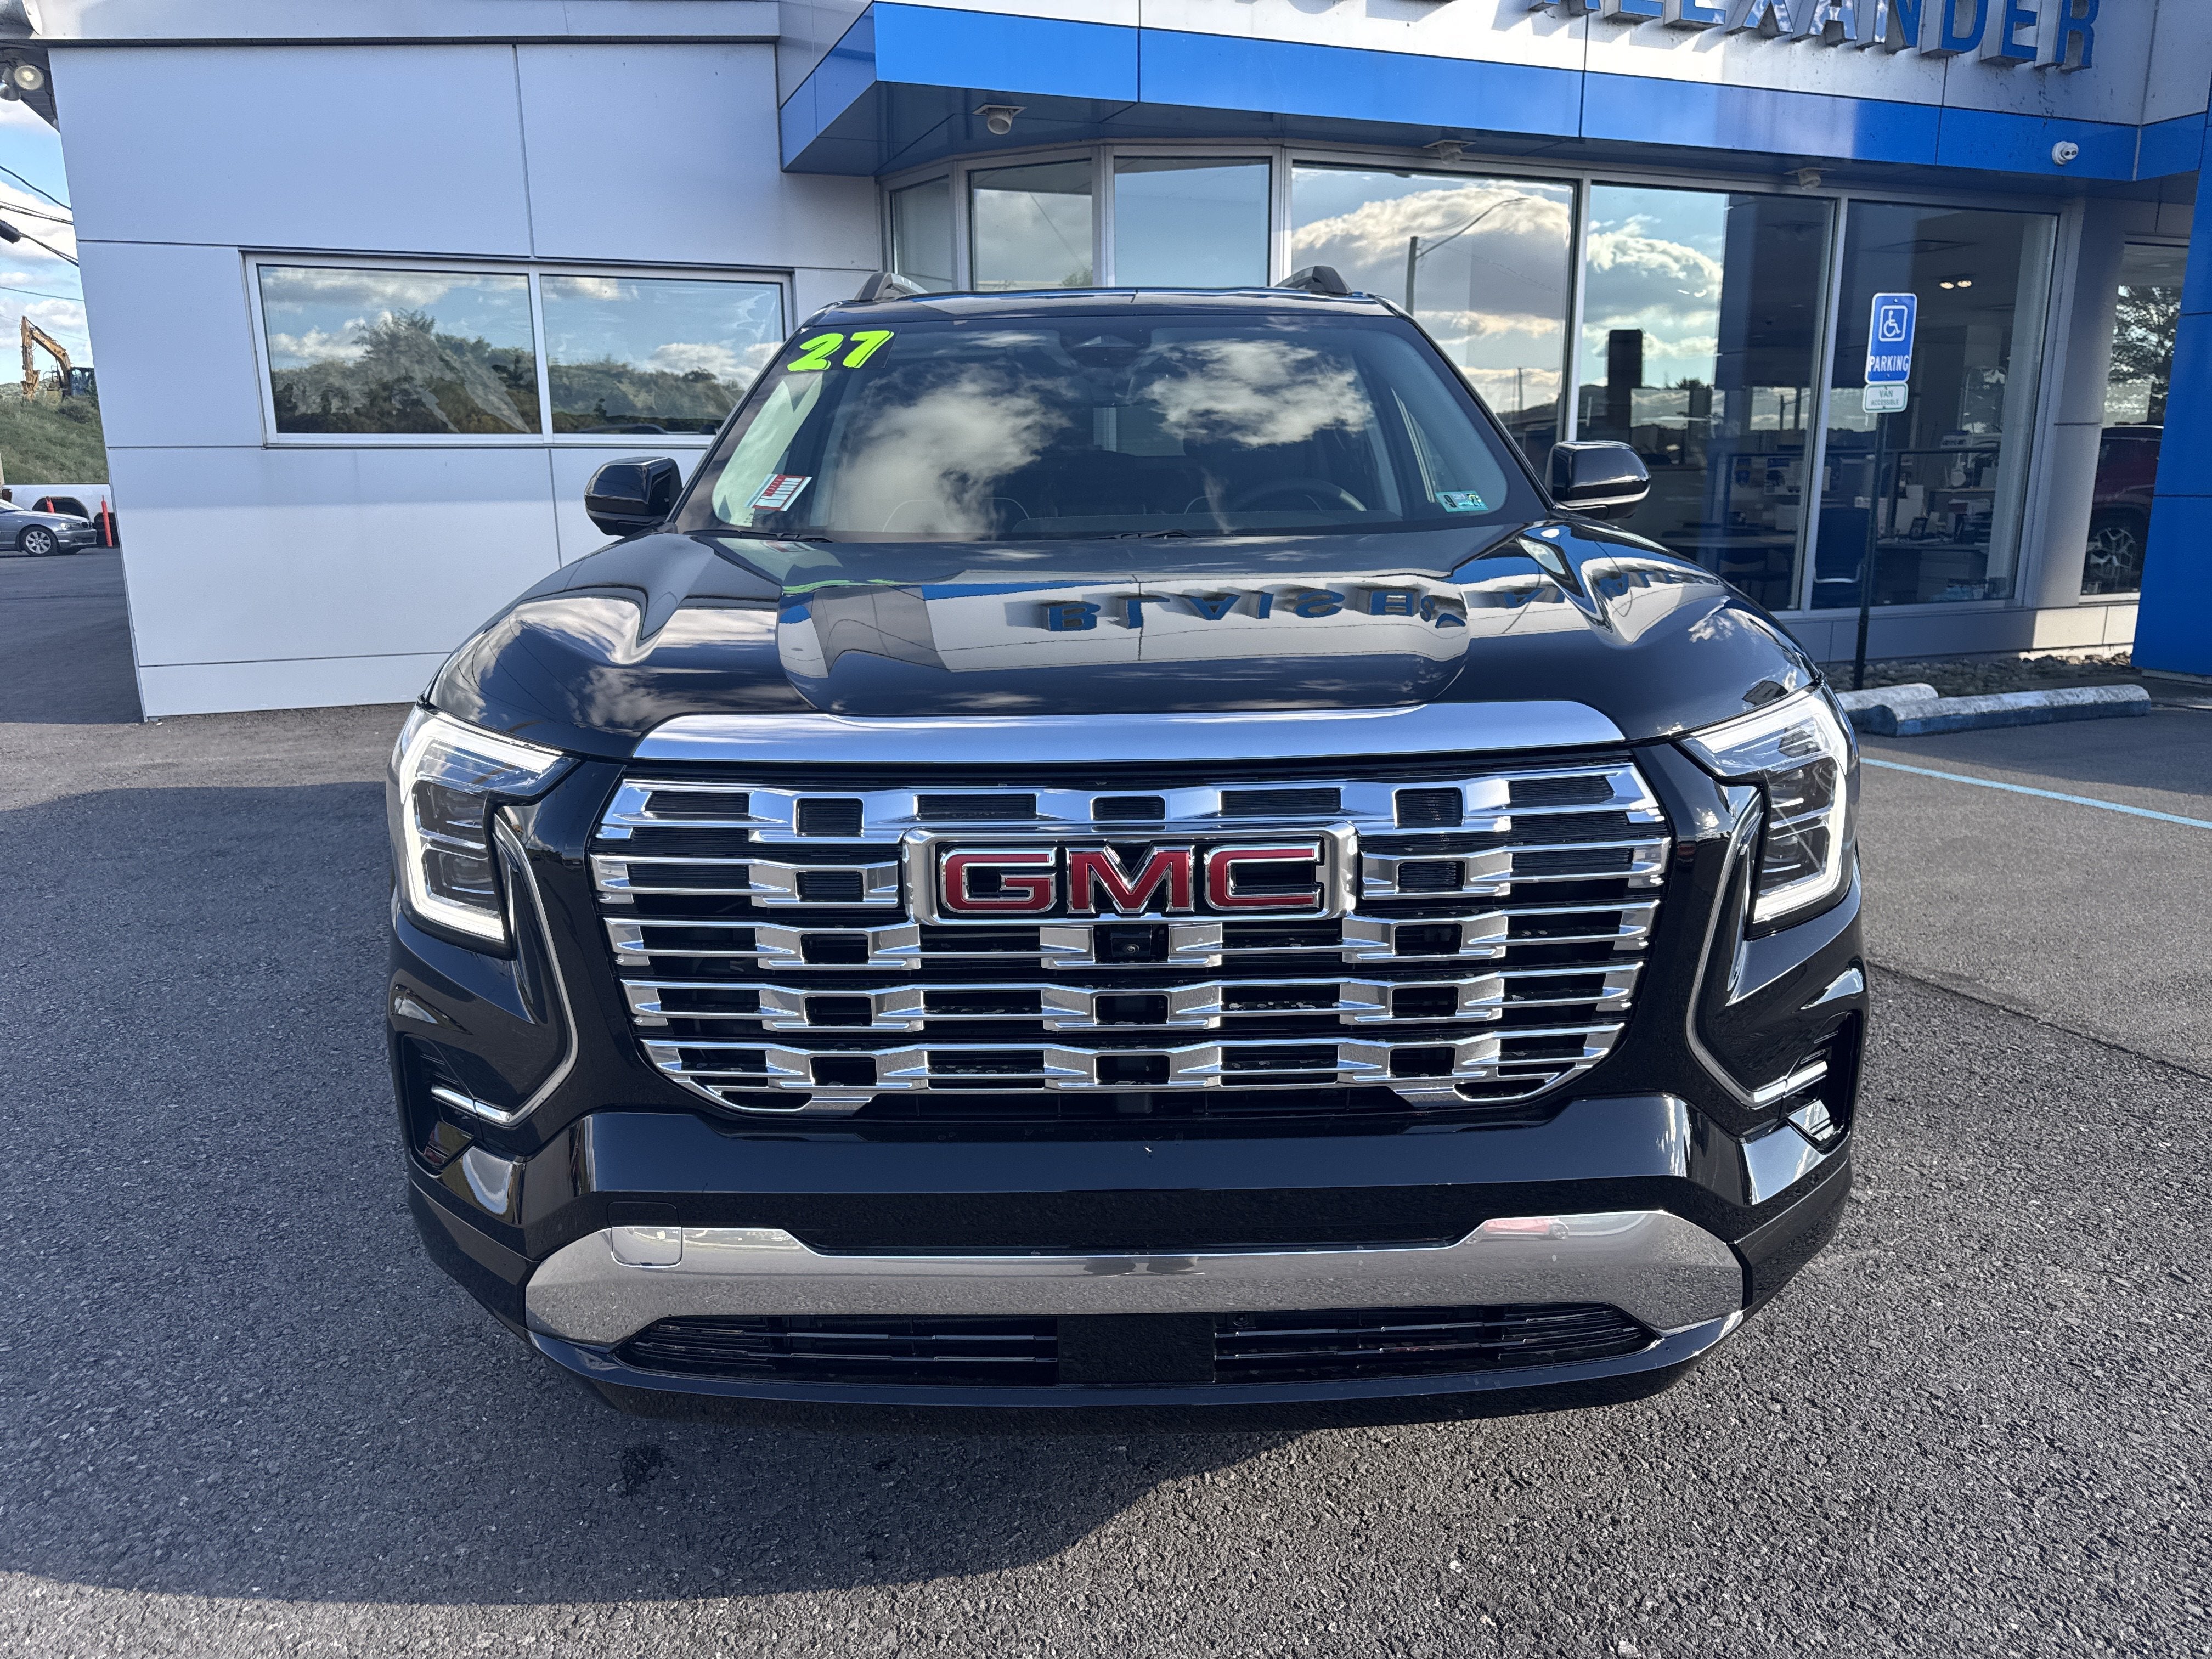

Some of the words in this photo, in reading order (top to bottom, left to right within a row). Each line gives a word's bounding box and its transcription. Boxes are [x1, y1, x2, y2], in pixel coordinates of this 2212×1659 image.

[787, 330, 894, 371] 27
[1869, 354, 1910, 372] PARKING
[939, 844, 1321, 915] GMC
